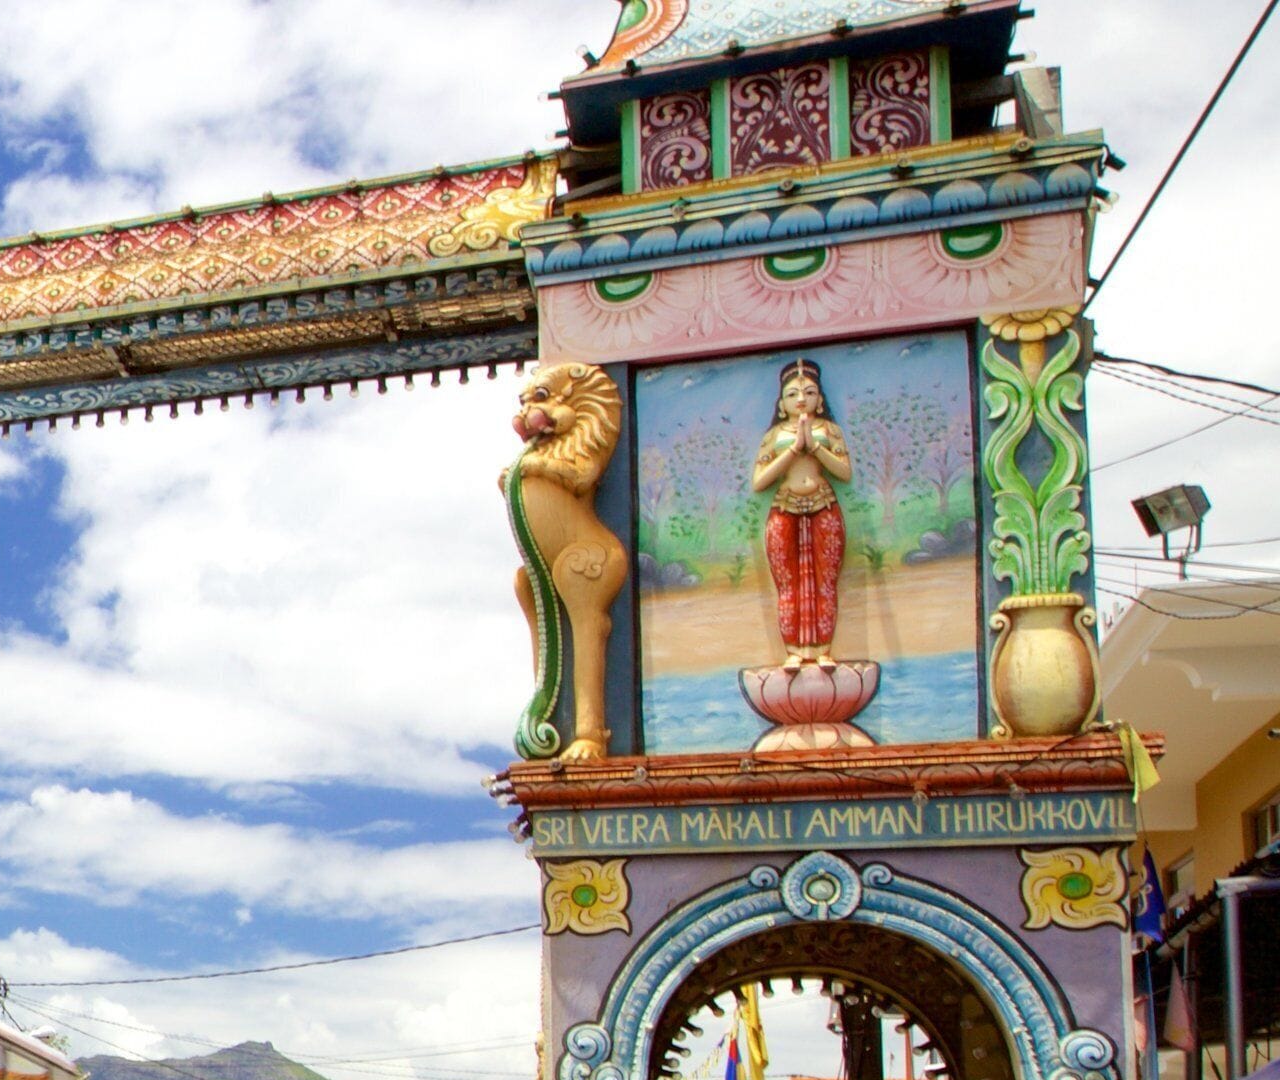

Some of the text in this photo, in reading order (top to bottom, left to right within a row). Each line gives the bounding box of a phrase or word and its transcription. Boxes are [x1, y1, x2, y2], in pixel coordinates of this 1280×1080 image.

[536, 816, 574, 847] SRI
[580, 812, 671, 844] VEERA
[803, 805, 923, 839] AMMAN
[935, 796, 1134, 834] THIRUKKOVIL
